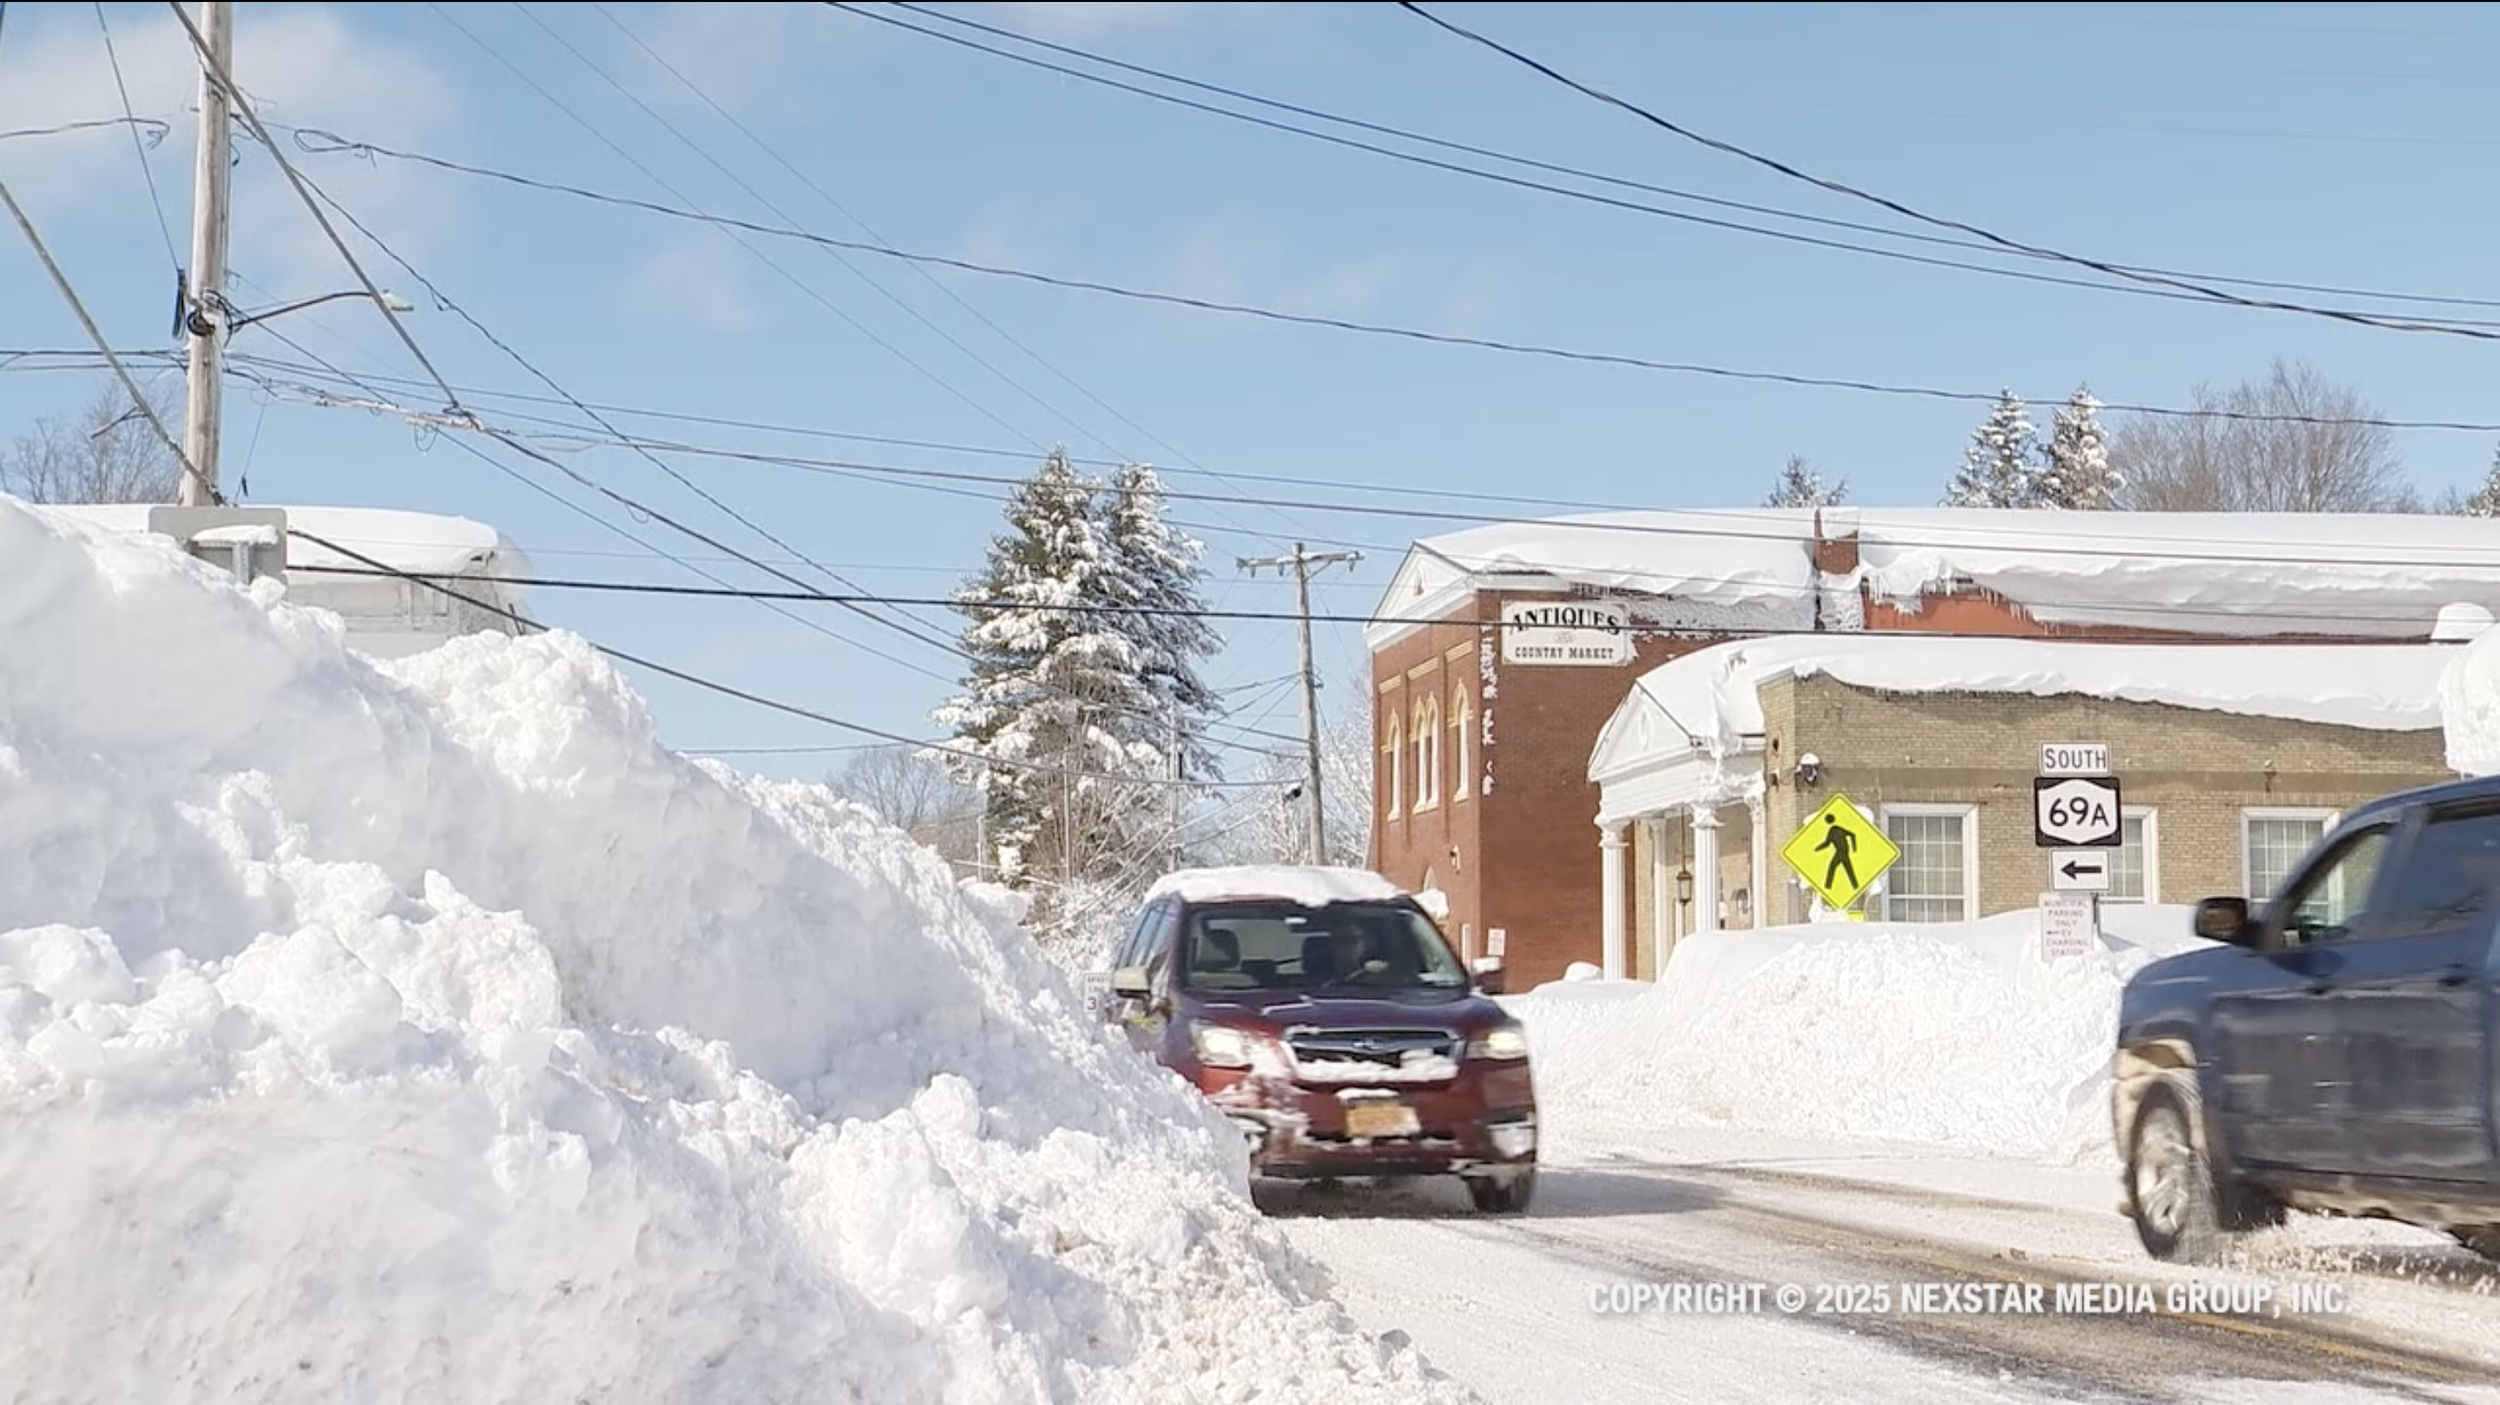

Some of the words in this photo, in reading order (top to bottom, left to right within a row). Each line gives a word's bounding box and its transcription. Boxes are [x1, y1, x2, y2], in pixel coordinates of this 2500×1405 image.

[1510, 606, 1620, 635] ANTIQUES
[1515, 646, 1563, 659] COUNTRY
[1569, 647, 1614, 659] MARKET
[2044, 747, 2106, 769] SOUTH
[2049, 796, 2109, 827] 69A
[2048, 909, 2084, 918] PARKING
[2055, 919, 2077, 927] ONLY
[2046, 938, 2089, 947] CHARGING
[2051, 948, 2084, 957] STATION
[1087, 996, 1097, 1011] 3
